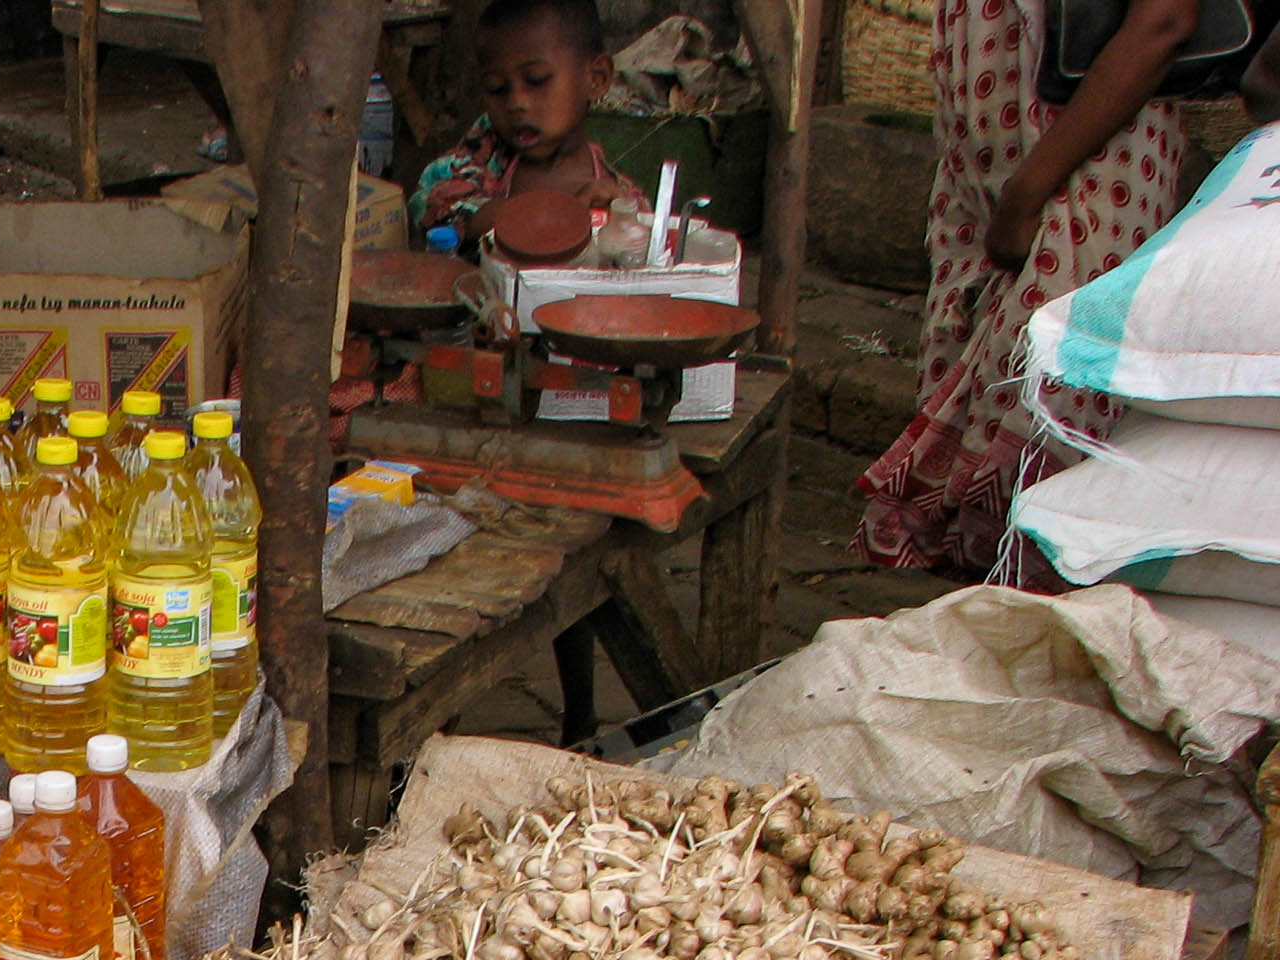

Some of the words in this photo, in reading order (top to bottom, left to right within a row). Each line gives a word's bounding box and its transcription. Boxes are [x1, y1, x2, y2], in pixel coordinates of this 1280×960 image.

[3, 294, 37, 312] nefa
[32, 601, 49, 612] oil
[9, 662, 48, 679] MENDY
